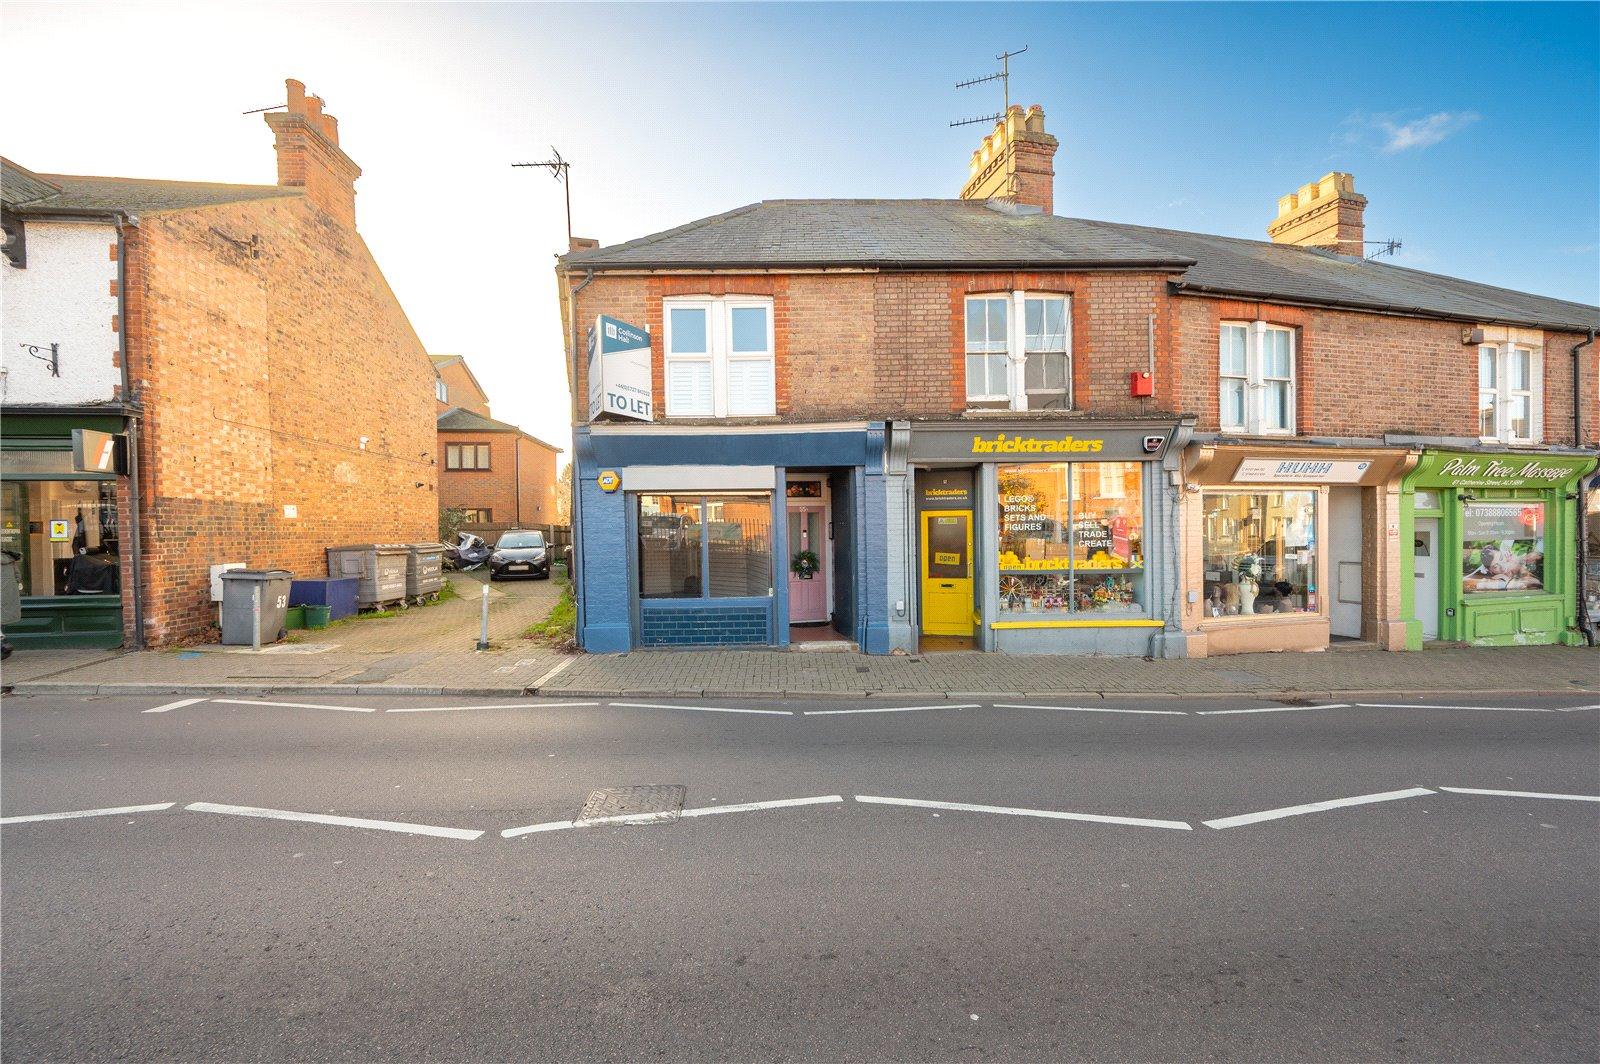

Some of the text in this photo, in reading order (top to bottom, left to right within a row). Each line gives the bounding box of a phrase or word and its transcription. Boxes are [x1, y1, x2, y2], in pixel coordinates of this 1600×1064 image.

[618, 327, 643, 342] Collinson
[618, 335, 630, 344] Hall
[607, 392, 650, 416] TO LET
[971, 433, 1104, 453] bricktraders
[1439, 457, 1573, 481] Palm Tree Massage
[925, 488, 968, 496] bricktraders
[1004, 514, 1027, 522] SETS
[1078, 512, 1097, 520] BUY
[1004, 523, 1042, 531] FIGURES
[1078, 521, 1100, 529] SELL
[1078, 530, 1108, 538] TRADE
[1078, 540, 1112, 548] CREATE
[276, 595, 287, 609] 53
